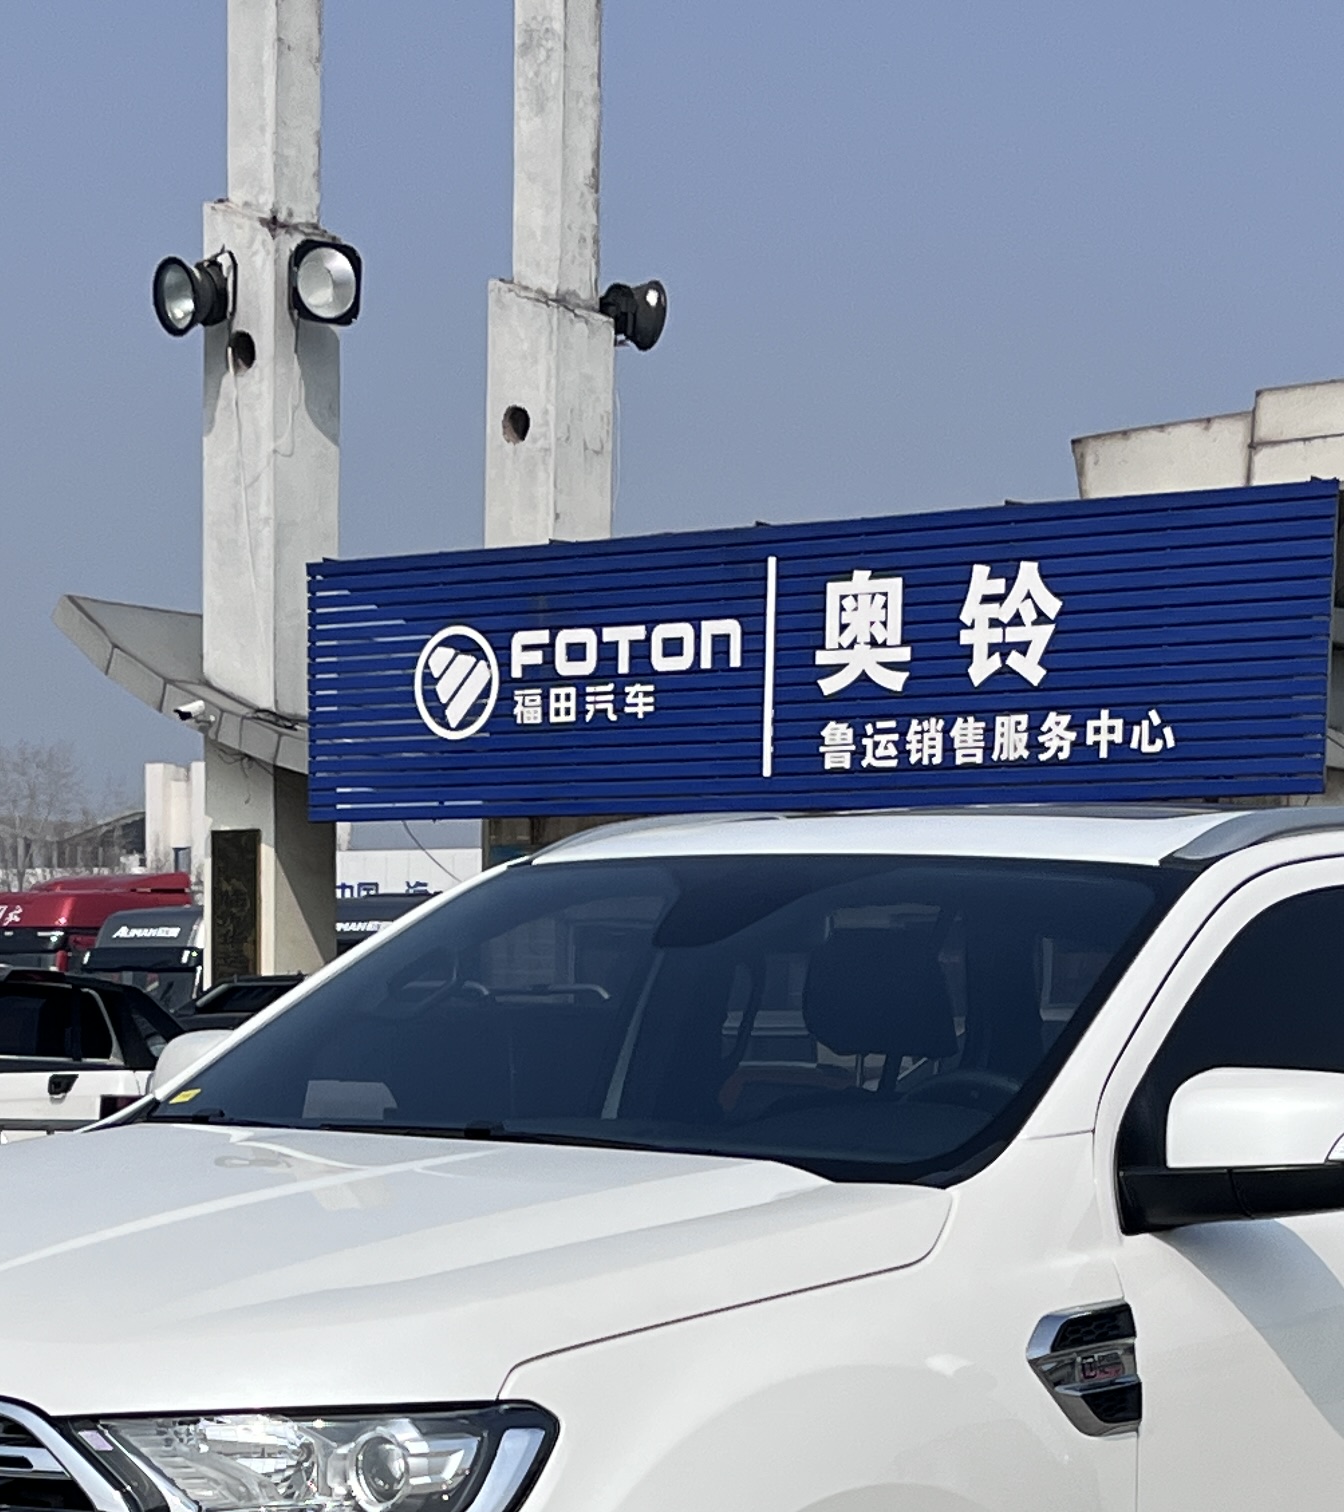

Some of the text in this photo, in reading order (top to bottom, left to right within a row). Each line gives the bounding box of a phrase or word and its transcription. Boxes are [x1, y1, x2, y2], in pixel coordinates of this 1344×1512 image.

[511, 618, 742, 679] FOTON
[815, 560, 1063, 696] 奥铃
[514, 683, 655, 724] 福田汽车
[818, 708, 1176, 770] 鲁运销售服务中心
